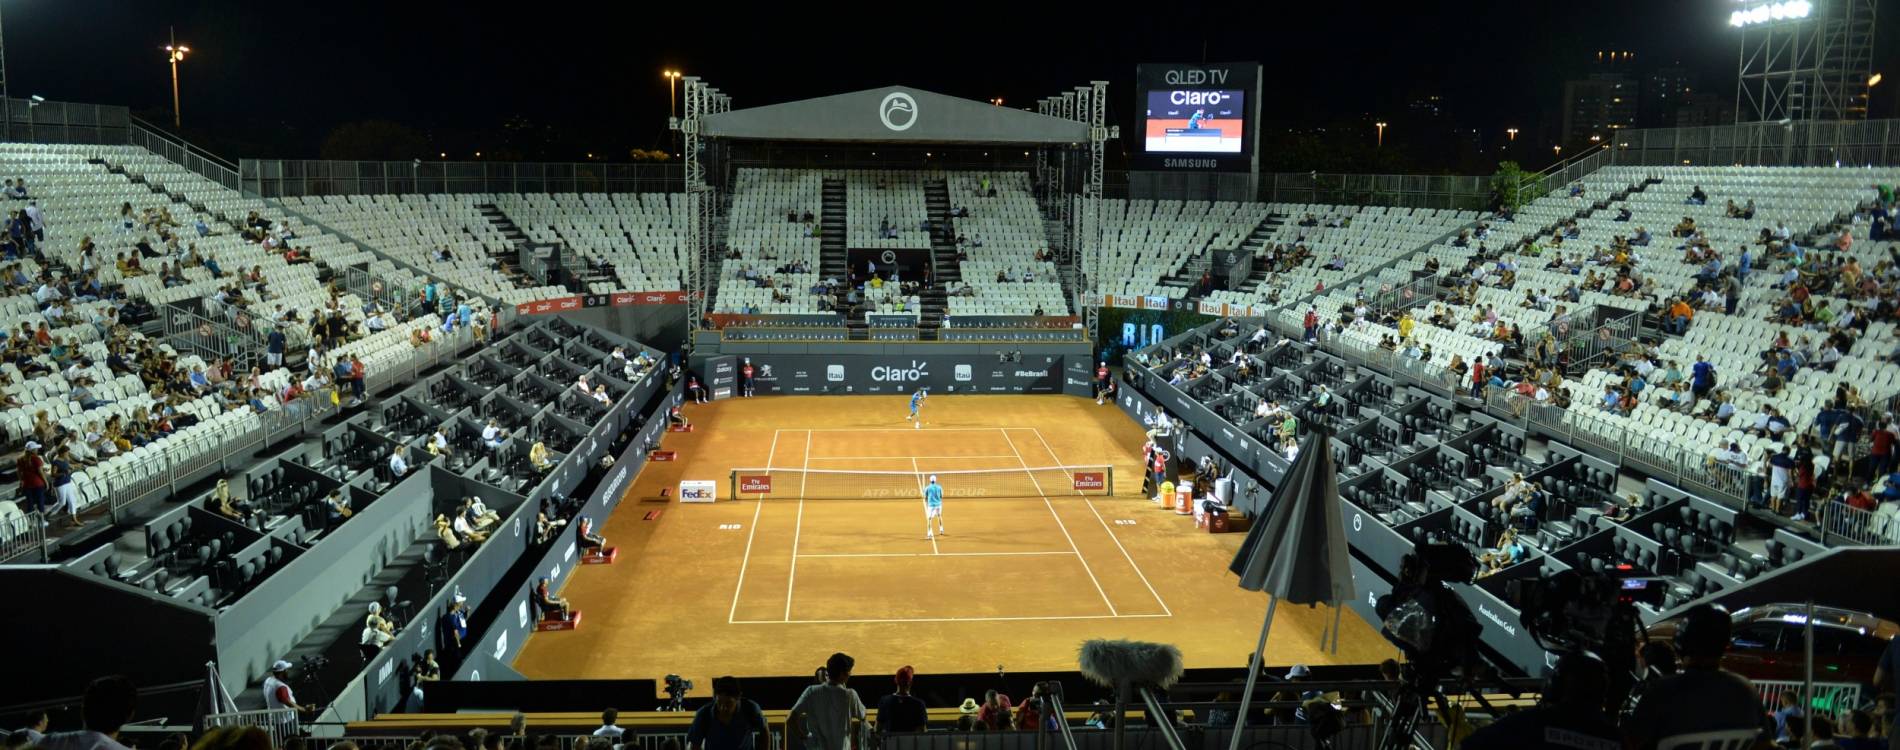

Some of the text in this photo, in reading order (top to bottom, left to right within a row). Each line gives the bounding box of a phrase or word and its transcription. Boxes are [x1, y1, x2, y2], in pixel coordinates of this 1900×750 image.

[1165, 69, 1229, 85] QLED TV
[1170, 90, 1221, 105] Claro
[1164, 159, 1217, 168] SAMSUNG
[1122, 322, 1164, 346] RIO
[871, 365, 920, 381] Claro
[742, 483, 769, 491] Emirates
[863, 488, 889, 497] ATP
[950, 488, 987, 497] TOUR
[682, 489, 712, 498] FedEx
